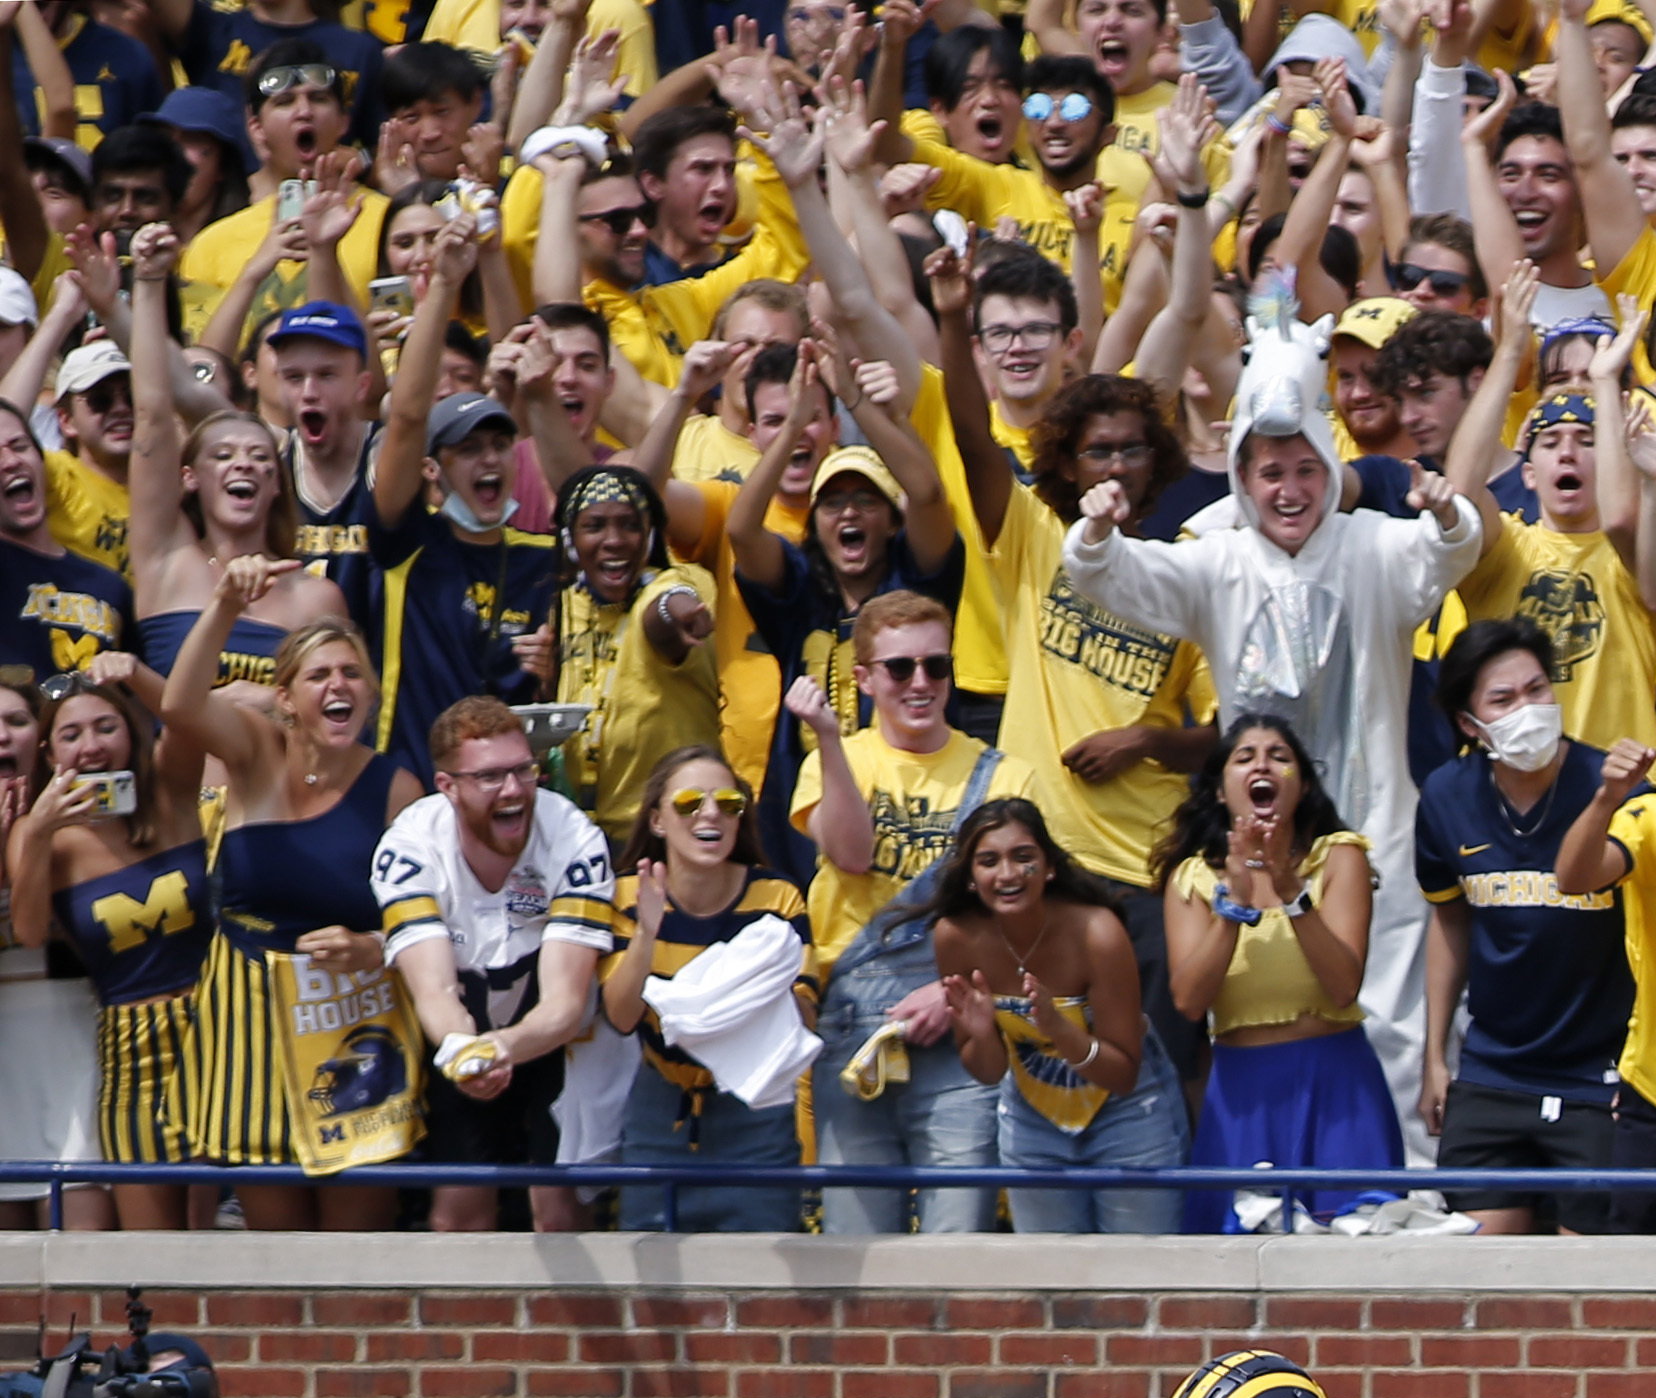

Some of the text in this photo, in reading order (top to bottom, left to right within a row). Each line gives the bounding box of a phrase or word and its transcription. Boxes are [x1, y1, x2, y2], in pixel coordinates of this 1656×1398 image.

[376, 849, 424, 885] 97
[565, 854, 607, 887] 97
[91, 869, 195, 953] M
[292, 981, 396, 1036] HOUSE
[318, 1121, 346, 1145] M
